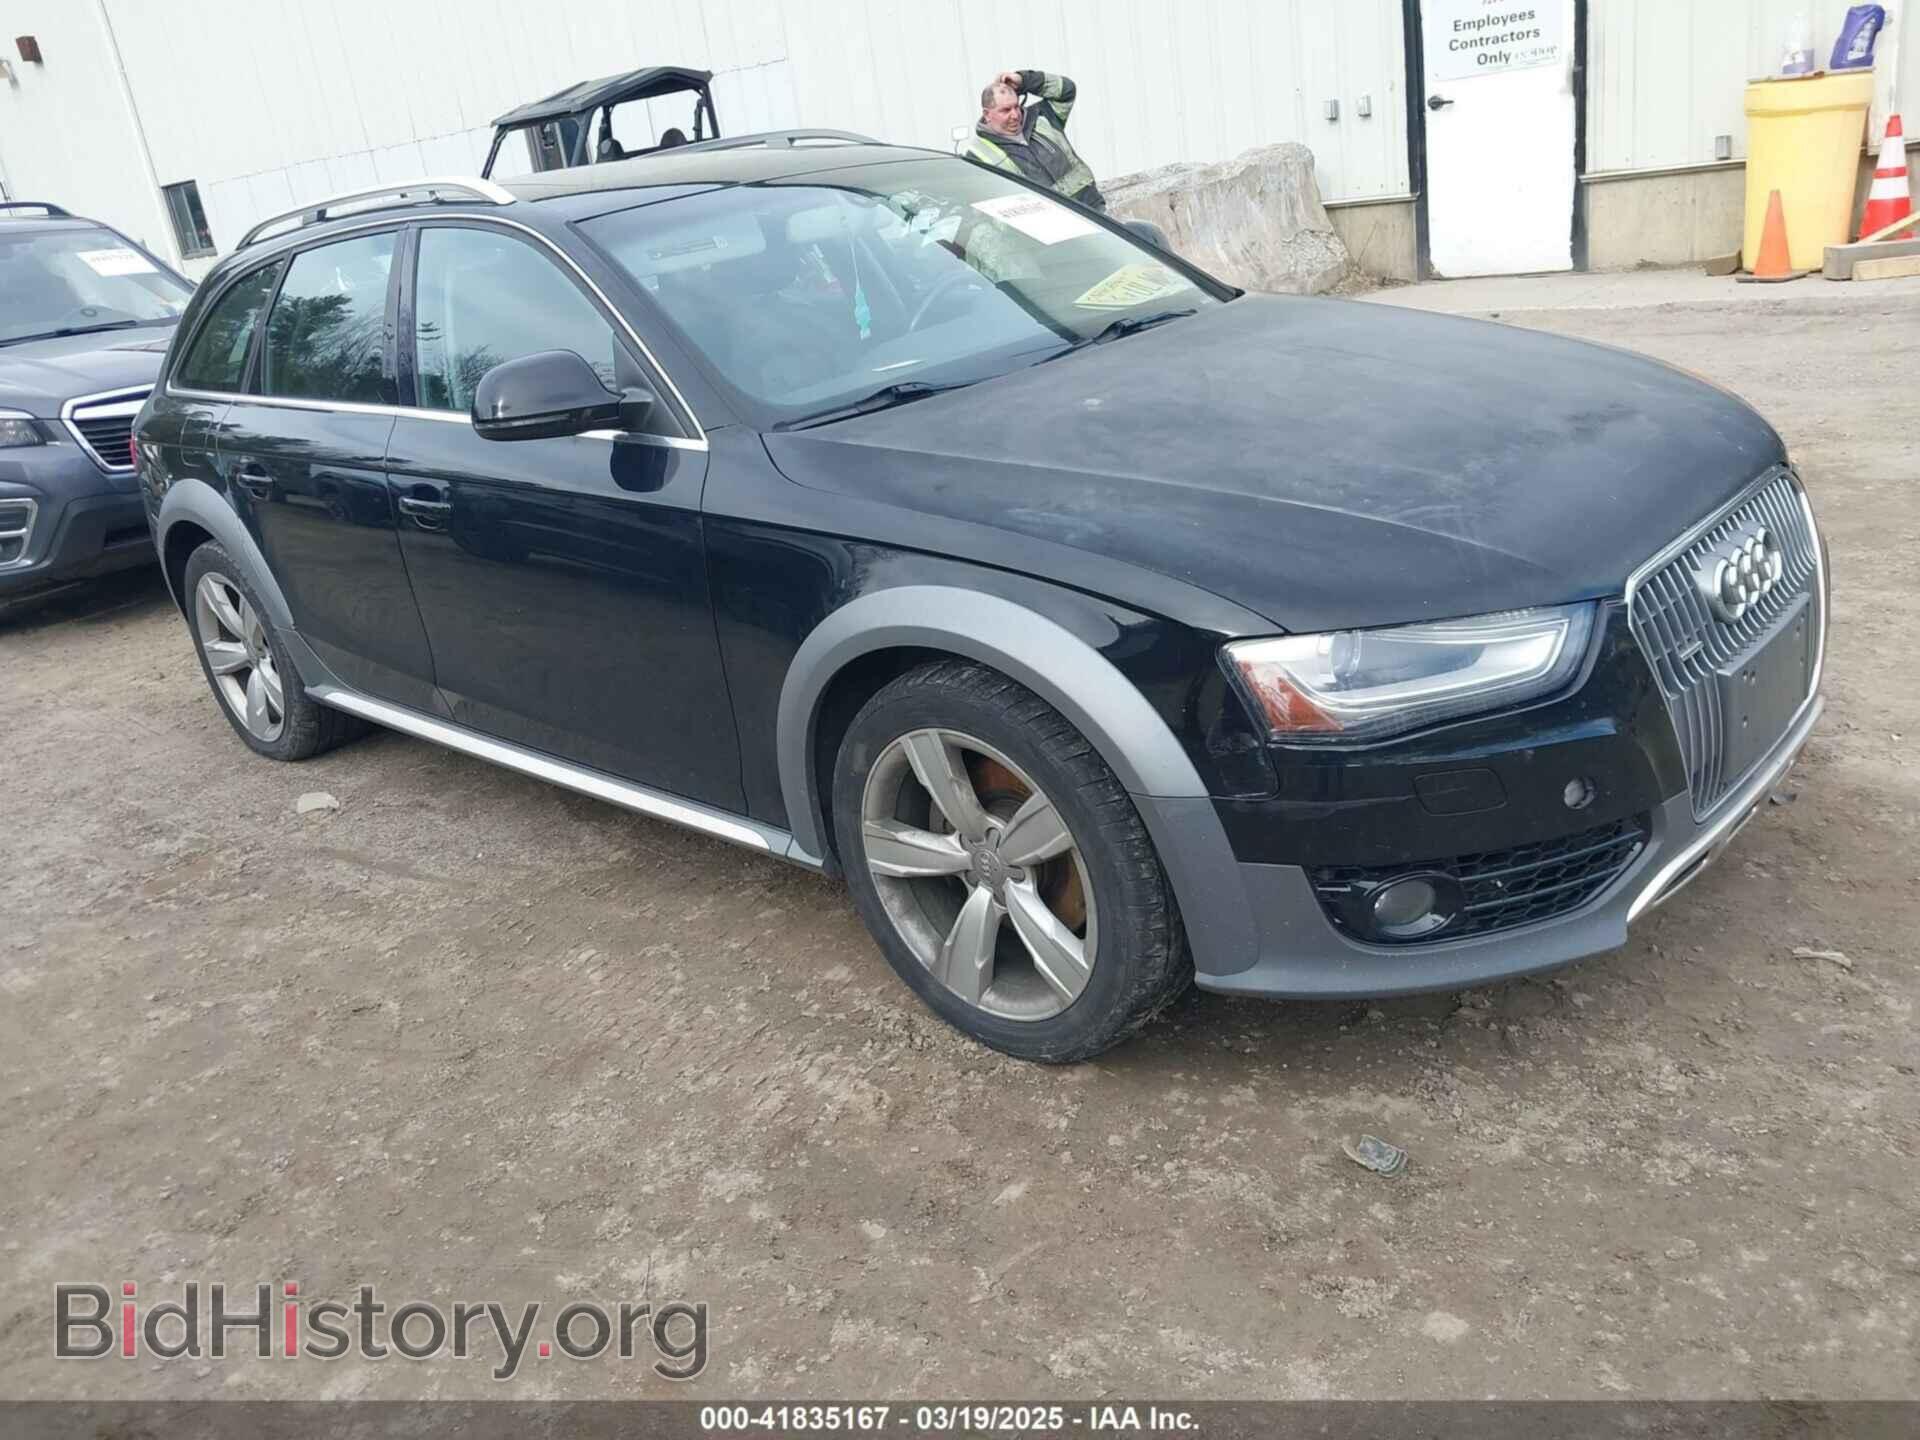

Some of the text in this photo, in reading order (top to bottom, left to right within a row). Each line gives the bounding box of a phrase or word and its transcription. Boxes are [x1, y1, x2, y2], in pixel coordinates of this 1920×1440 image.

[1453, 10, 1536, 31] Employees
[1449, 28, 1541, 51] Contractors
[1476, 51, 1512, 65] Only
